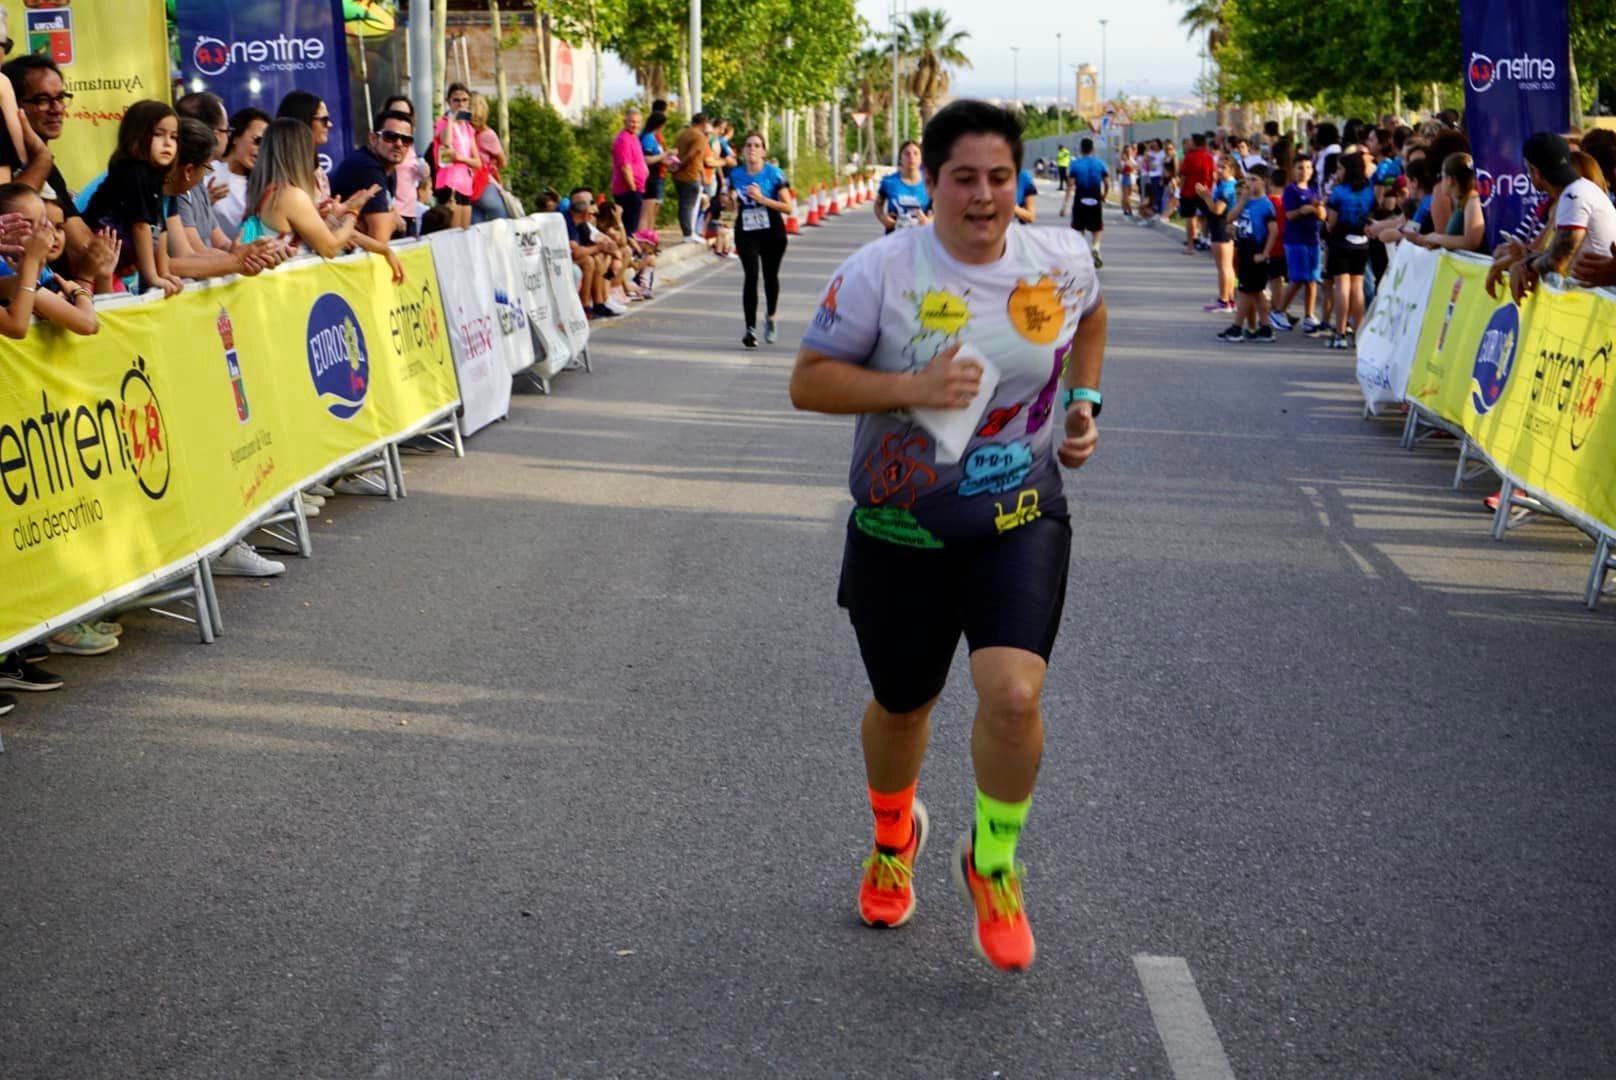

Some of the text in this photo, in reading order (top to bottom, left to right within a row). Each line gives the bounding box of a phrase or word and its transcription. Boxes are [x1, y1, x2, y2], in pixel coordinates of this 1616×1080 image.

[0, 389, 127, 506] entren
[13, 496, 104, 552] club deportivo
